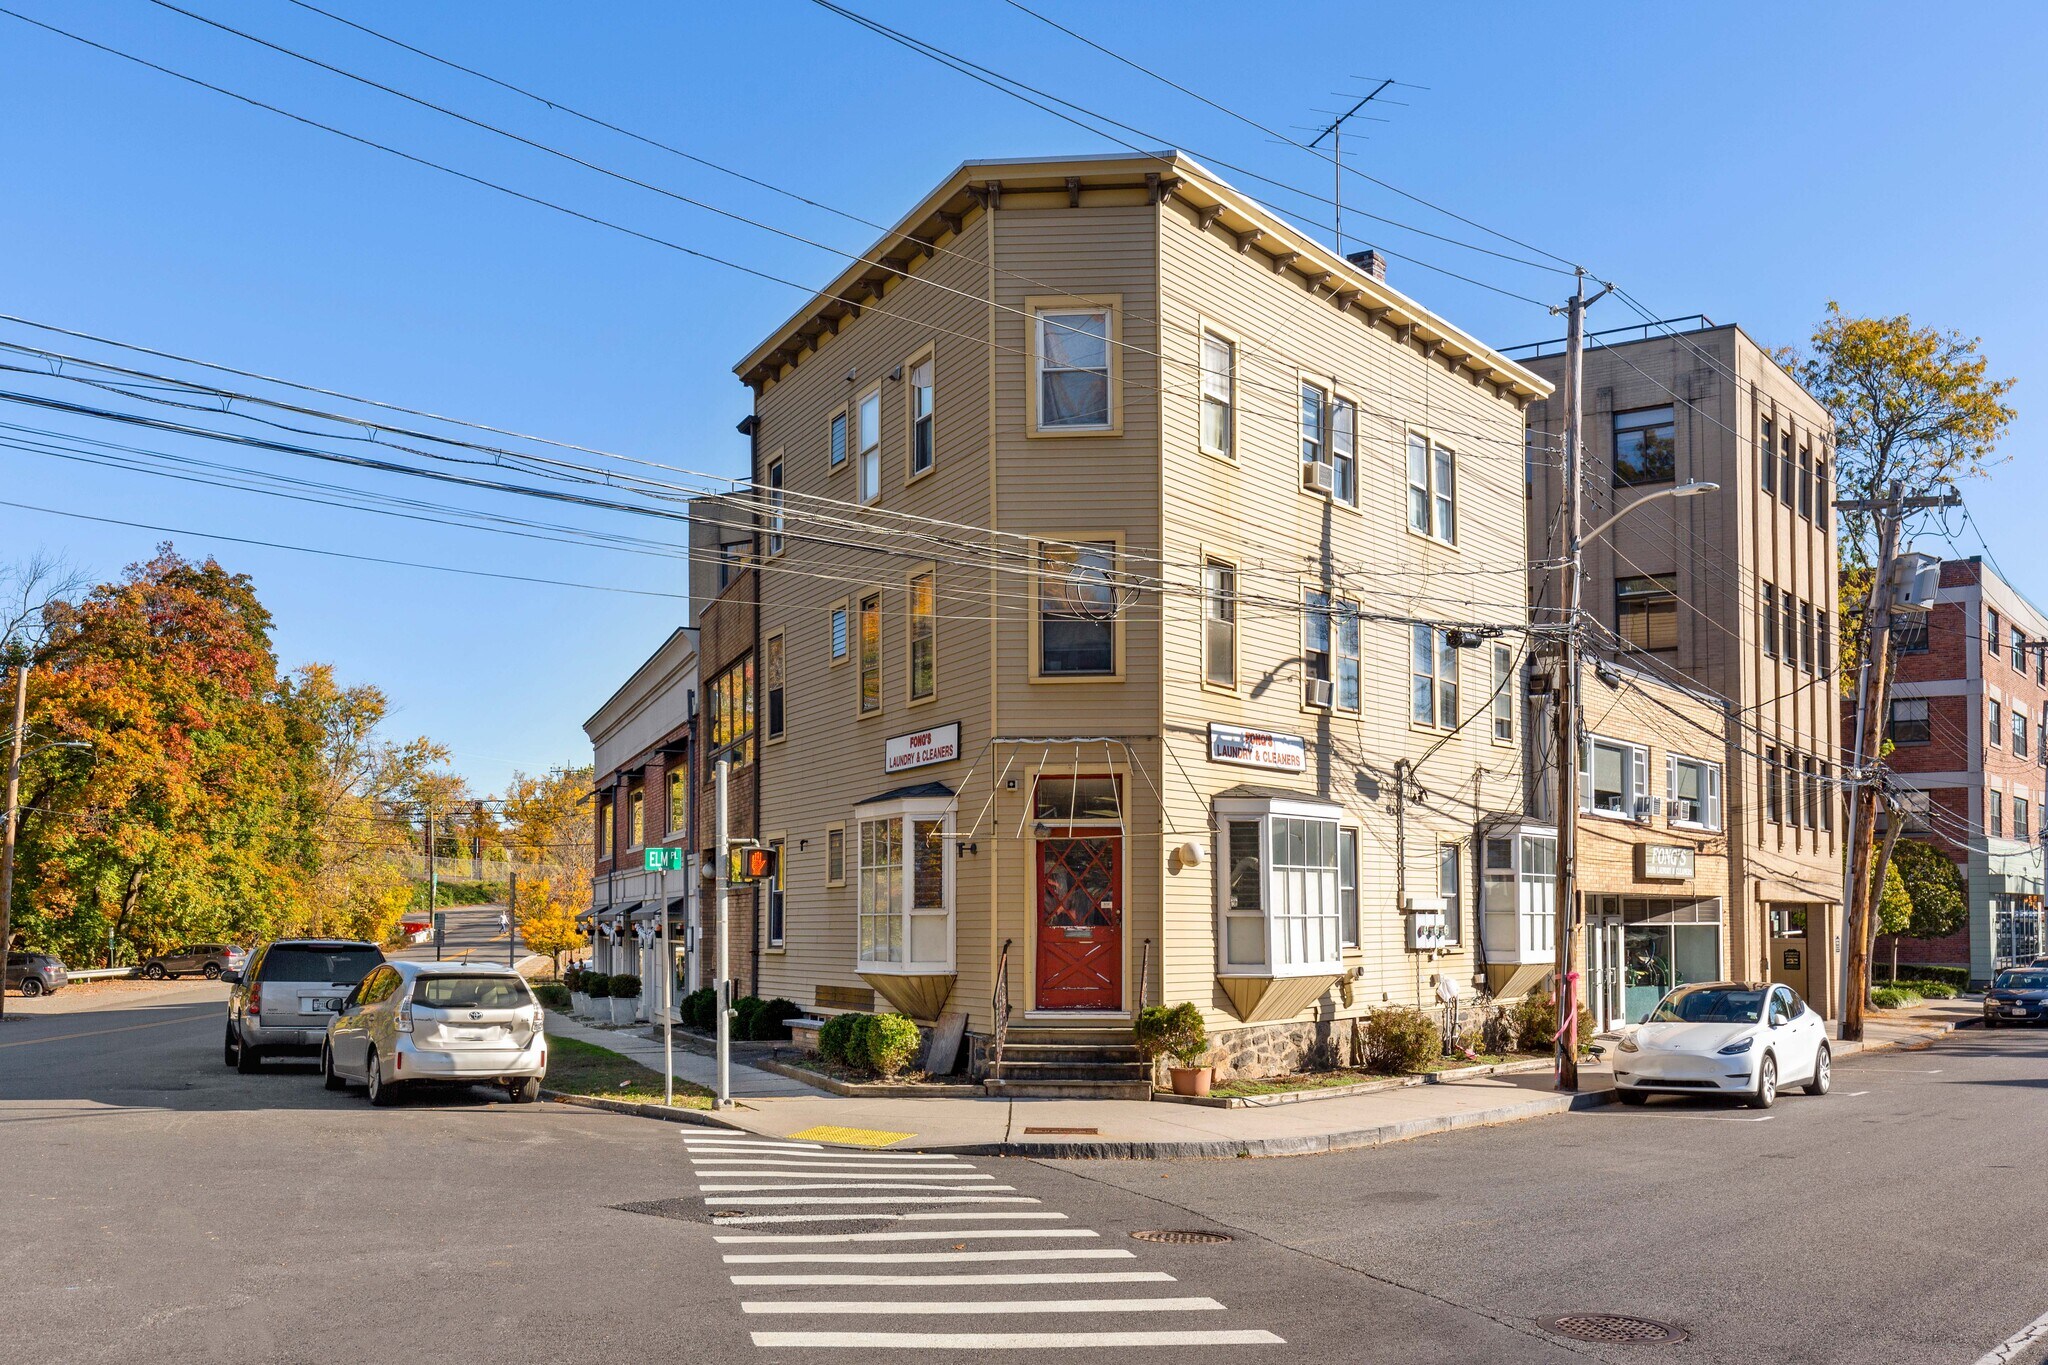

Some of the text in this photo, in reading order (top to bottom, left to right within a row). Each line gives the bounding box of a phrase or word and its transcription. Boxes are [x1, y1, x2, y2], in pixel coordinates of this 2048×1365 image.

[909, 732, 932, 748] FONG'S
[1245, 731, 1273, 747] FONG'S
[889, 744, 954, 768] LAUNDRY & CLEANERS
[1217, 744, 1300, 767] LAUNDRY & CLEANERS
[650, 851, 679, 867] ELM PL
[1652, 847, 1687, 866] FONG'S
